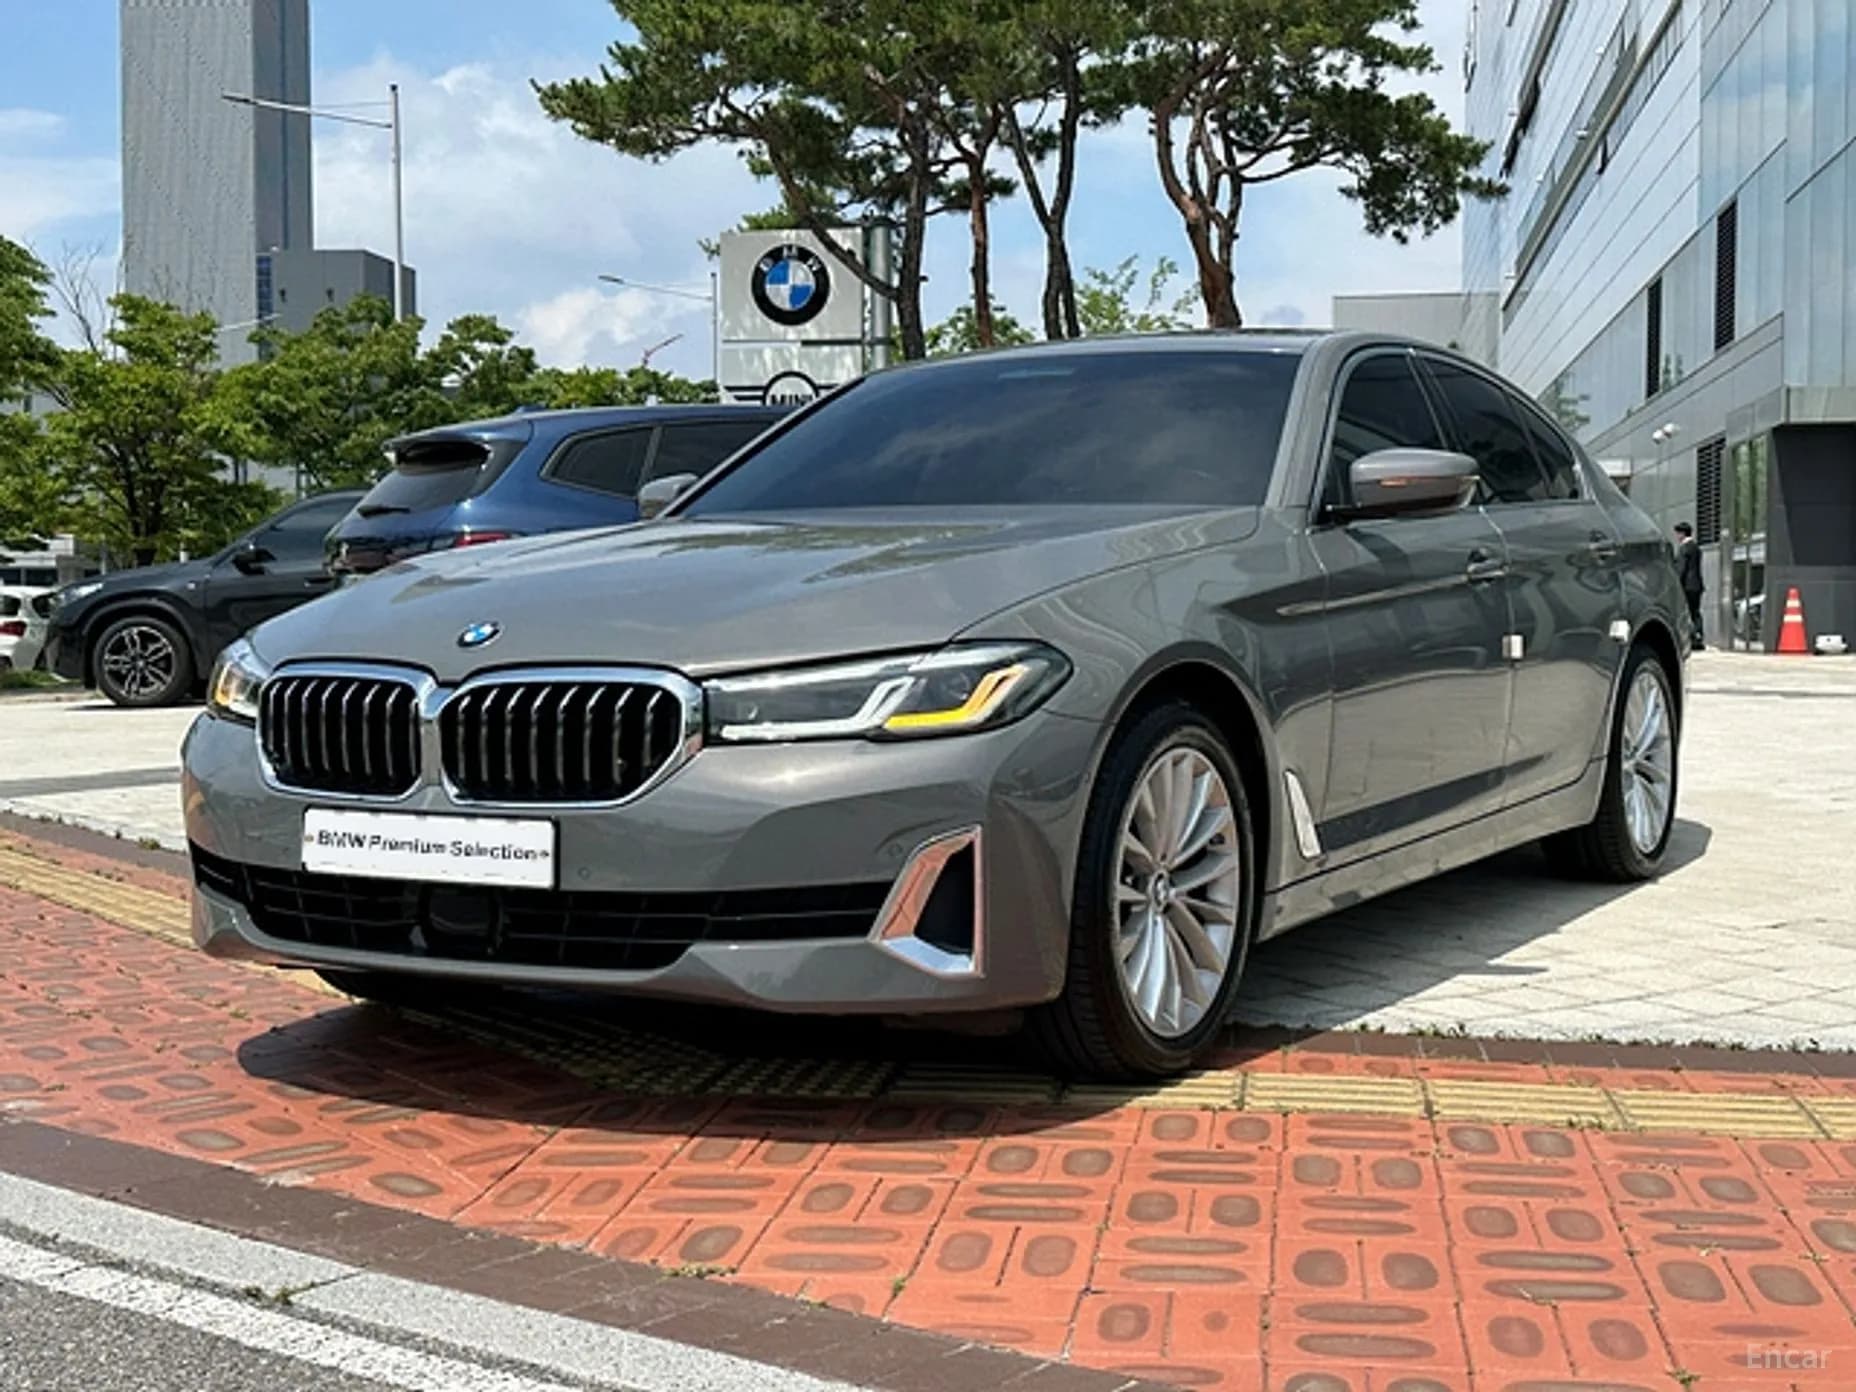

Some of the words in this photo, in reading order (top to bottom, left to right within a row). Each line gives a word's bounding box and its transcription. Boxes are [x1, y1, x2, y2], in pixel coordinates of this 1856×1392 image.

[759, 245, 821, 272] BMW
[318, 829, 367, 849] BMW
[368, 834, 447, 855] Premium
[449, 840, 538, 861] Selection
